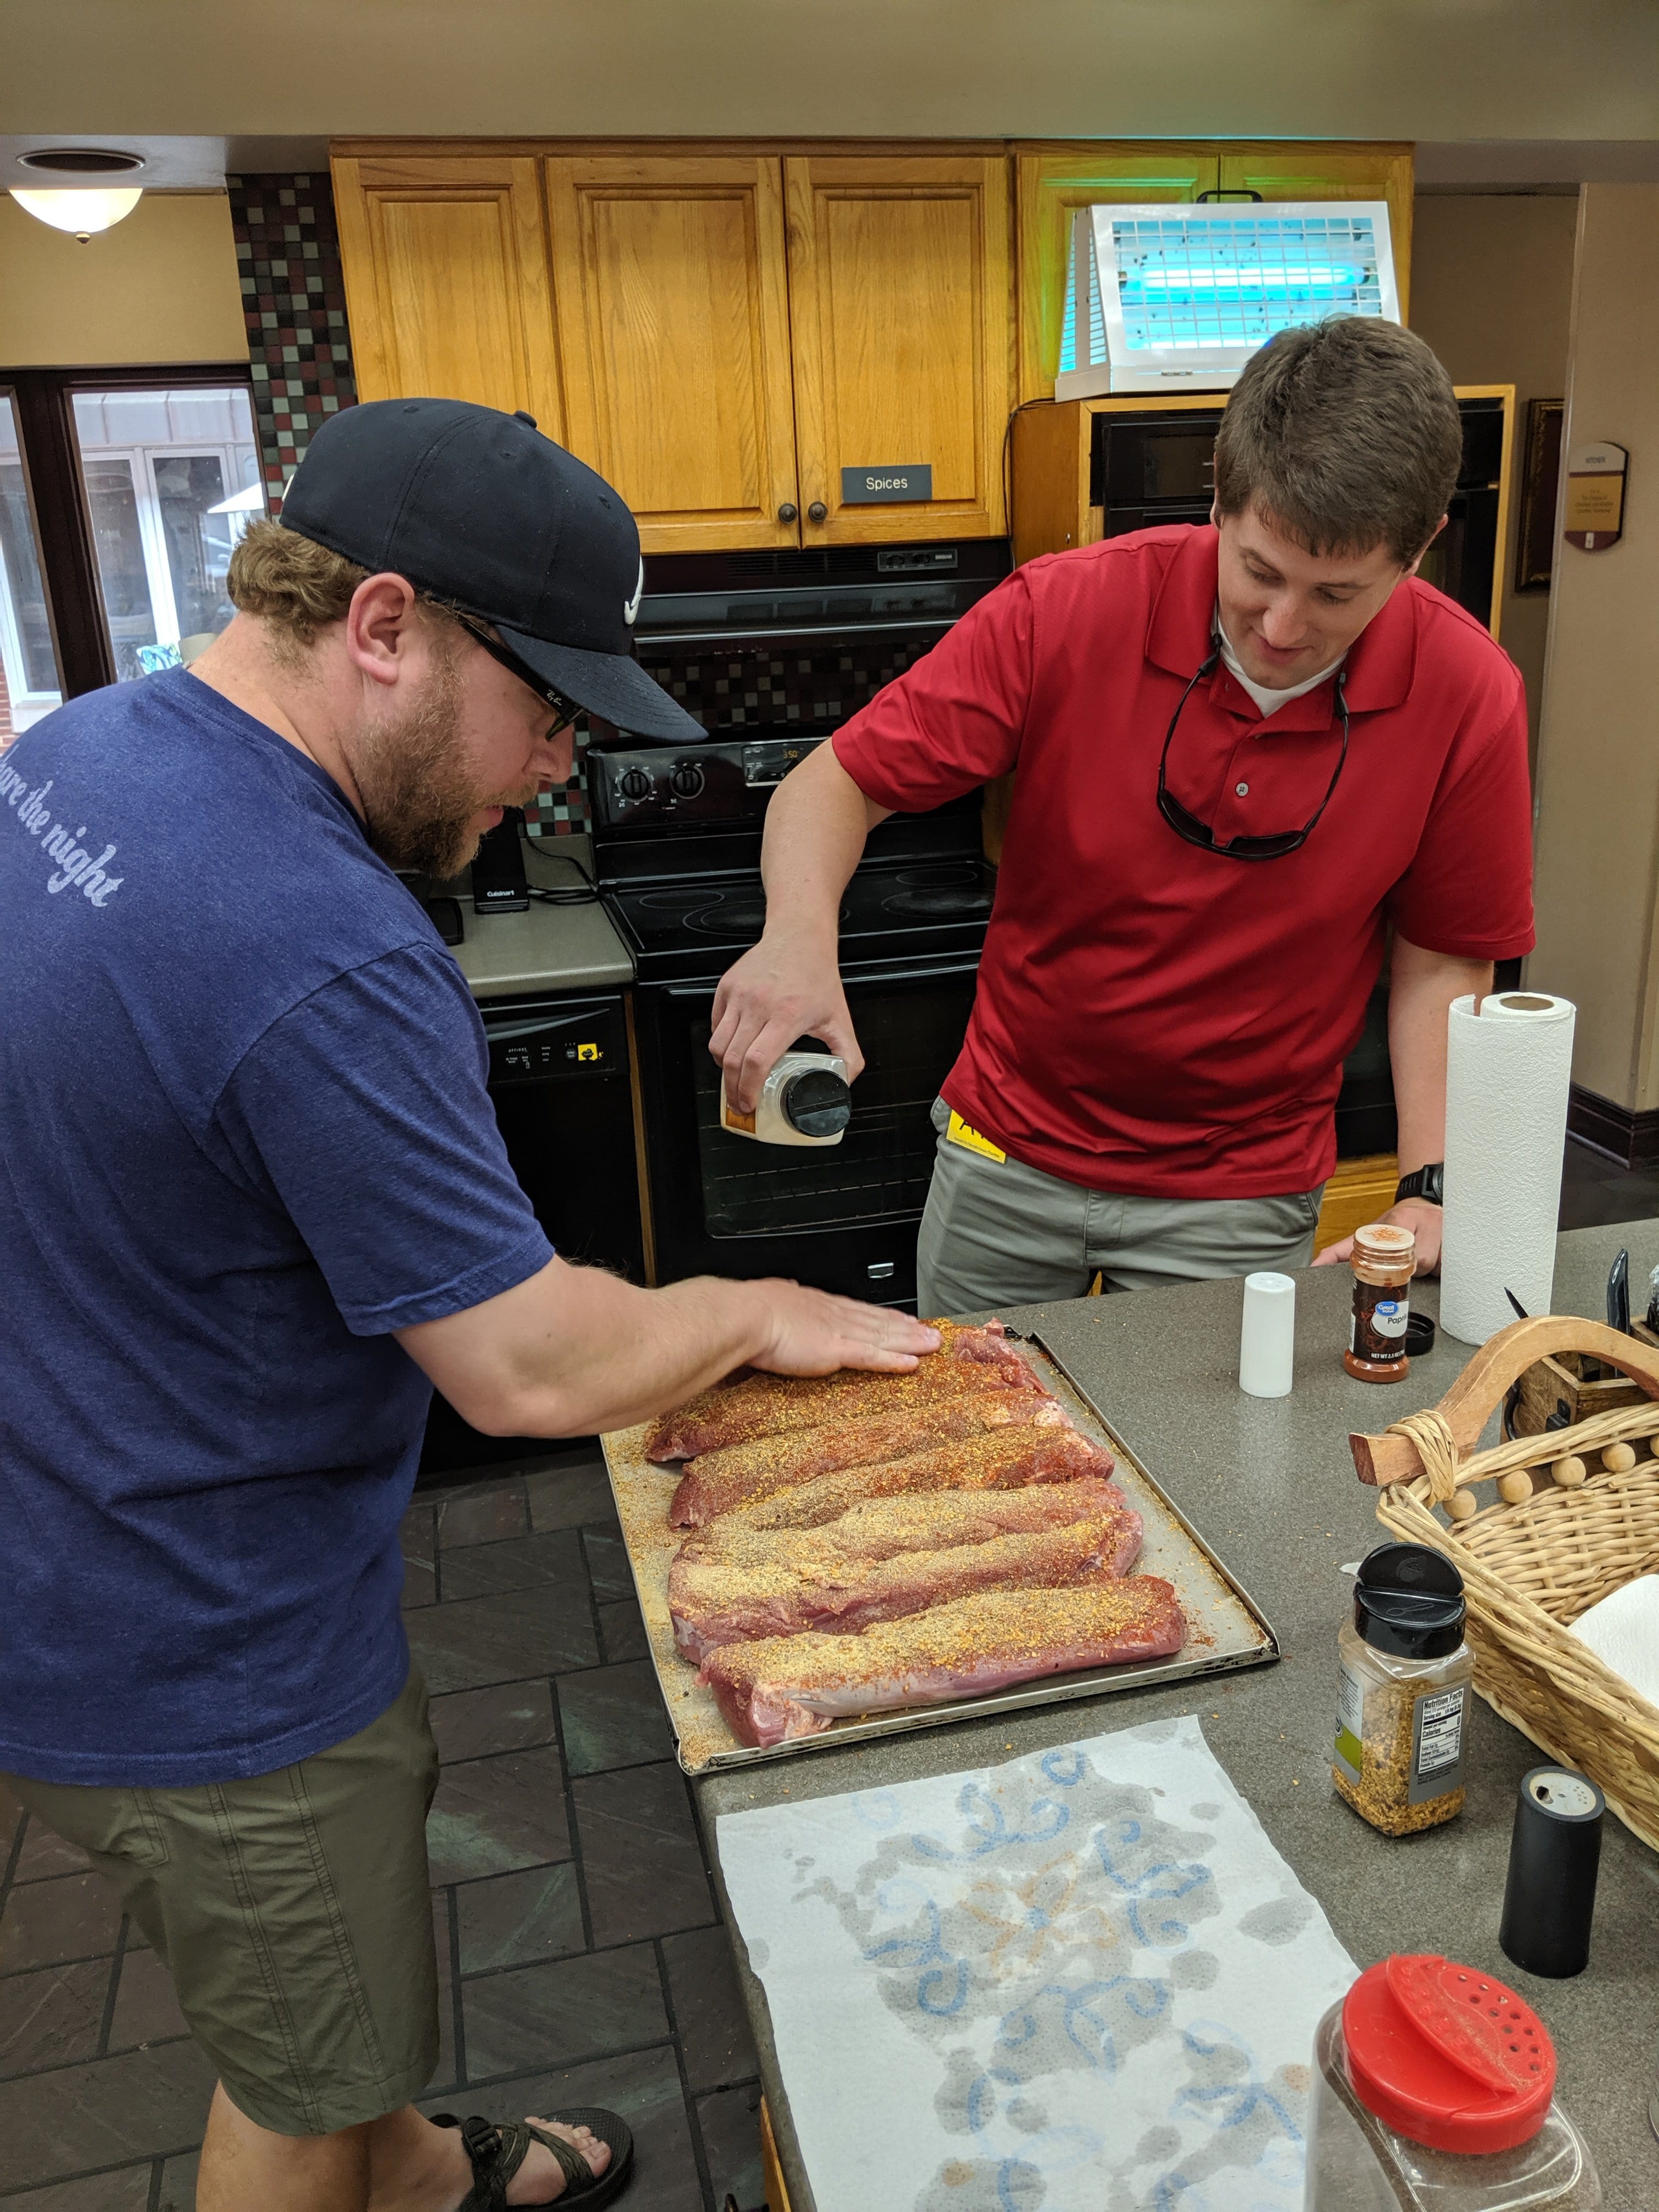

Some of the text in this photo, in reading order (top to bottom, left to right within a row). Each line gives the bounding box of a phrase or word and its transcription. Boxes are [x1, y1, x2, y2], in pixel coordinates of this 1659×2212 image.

[866, 477, 908, 492] Spices
[18, 780, 53, 835] the
[40, 824, 125, 907] night
[1424, 1697, 1448, 1709] Nutrition
[1449, 1690, 1463, 1701] Facts
[1423, 1728, 1441, 1737] Calories
